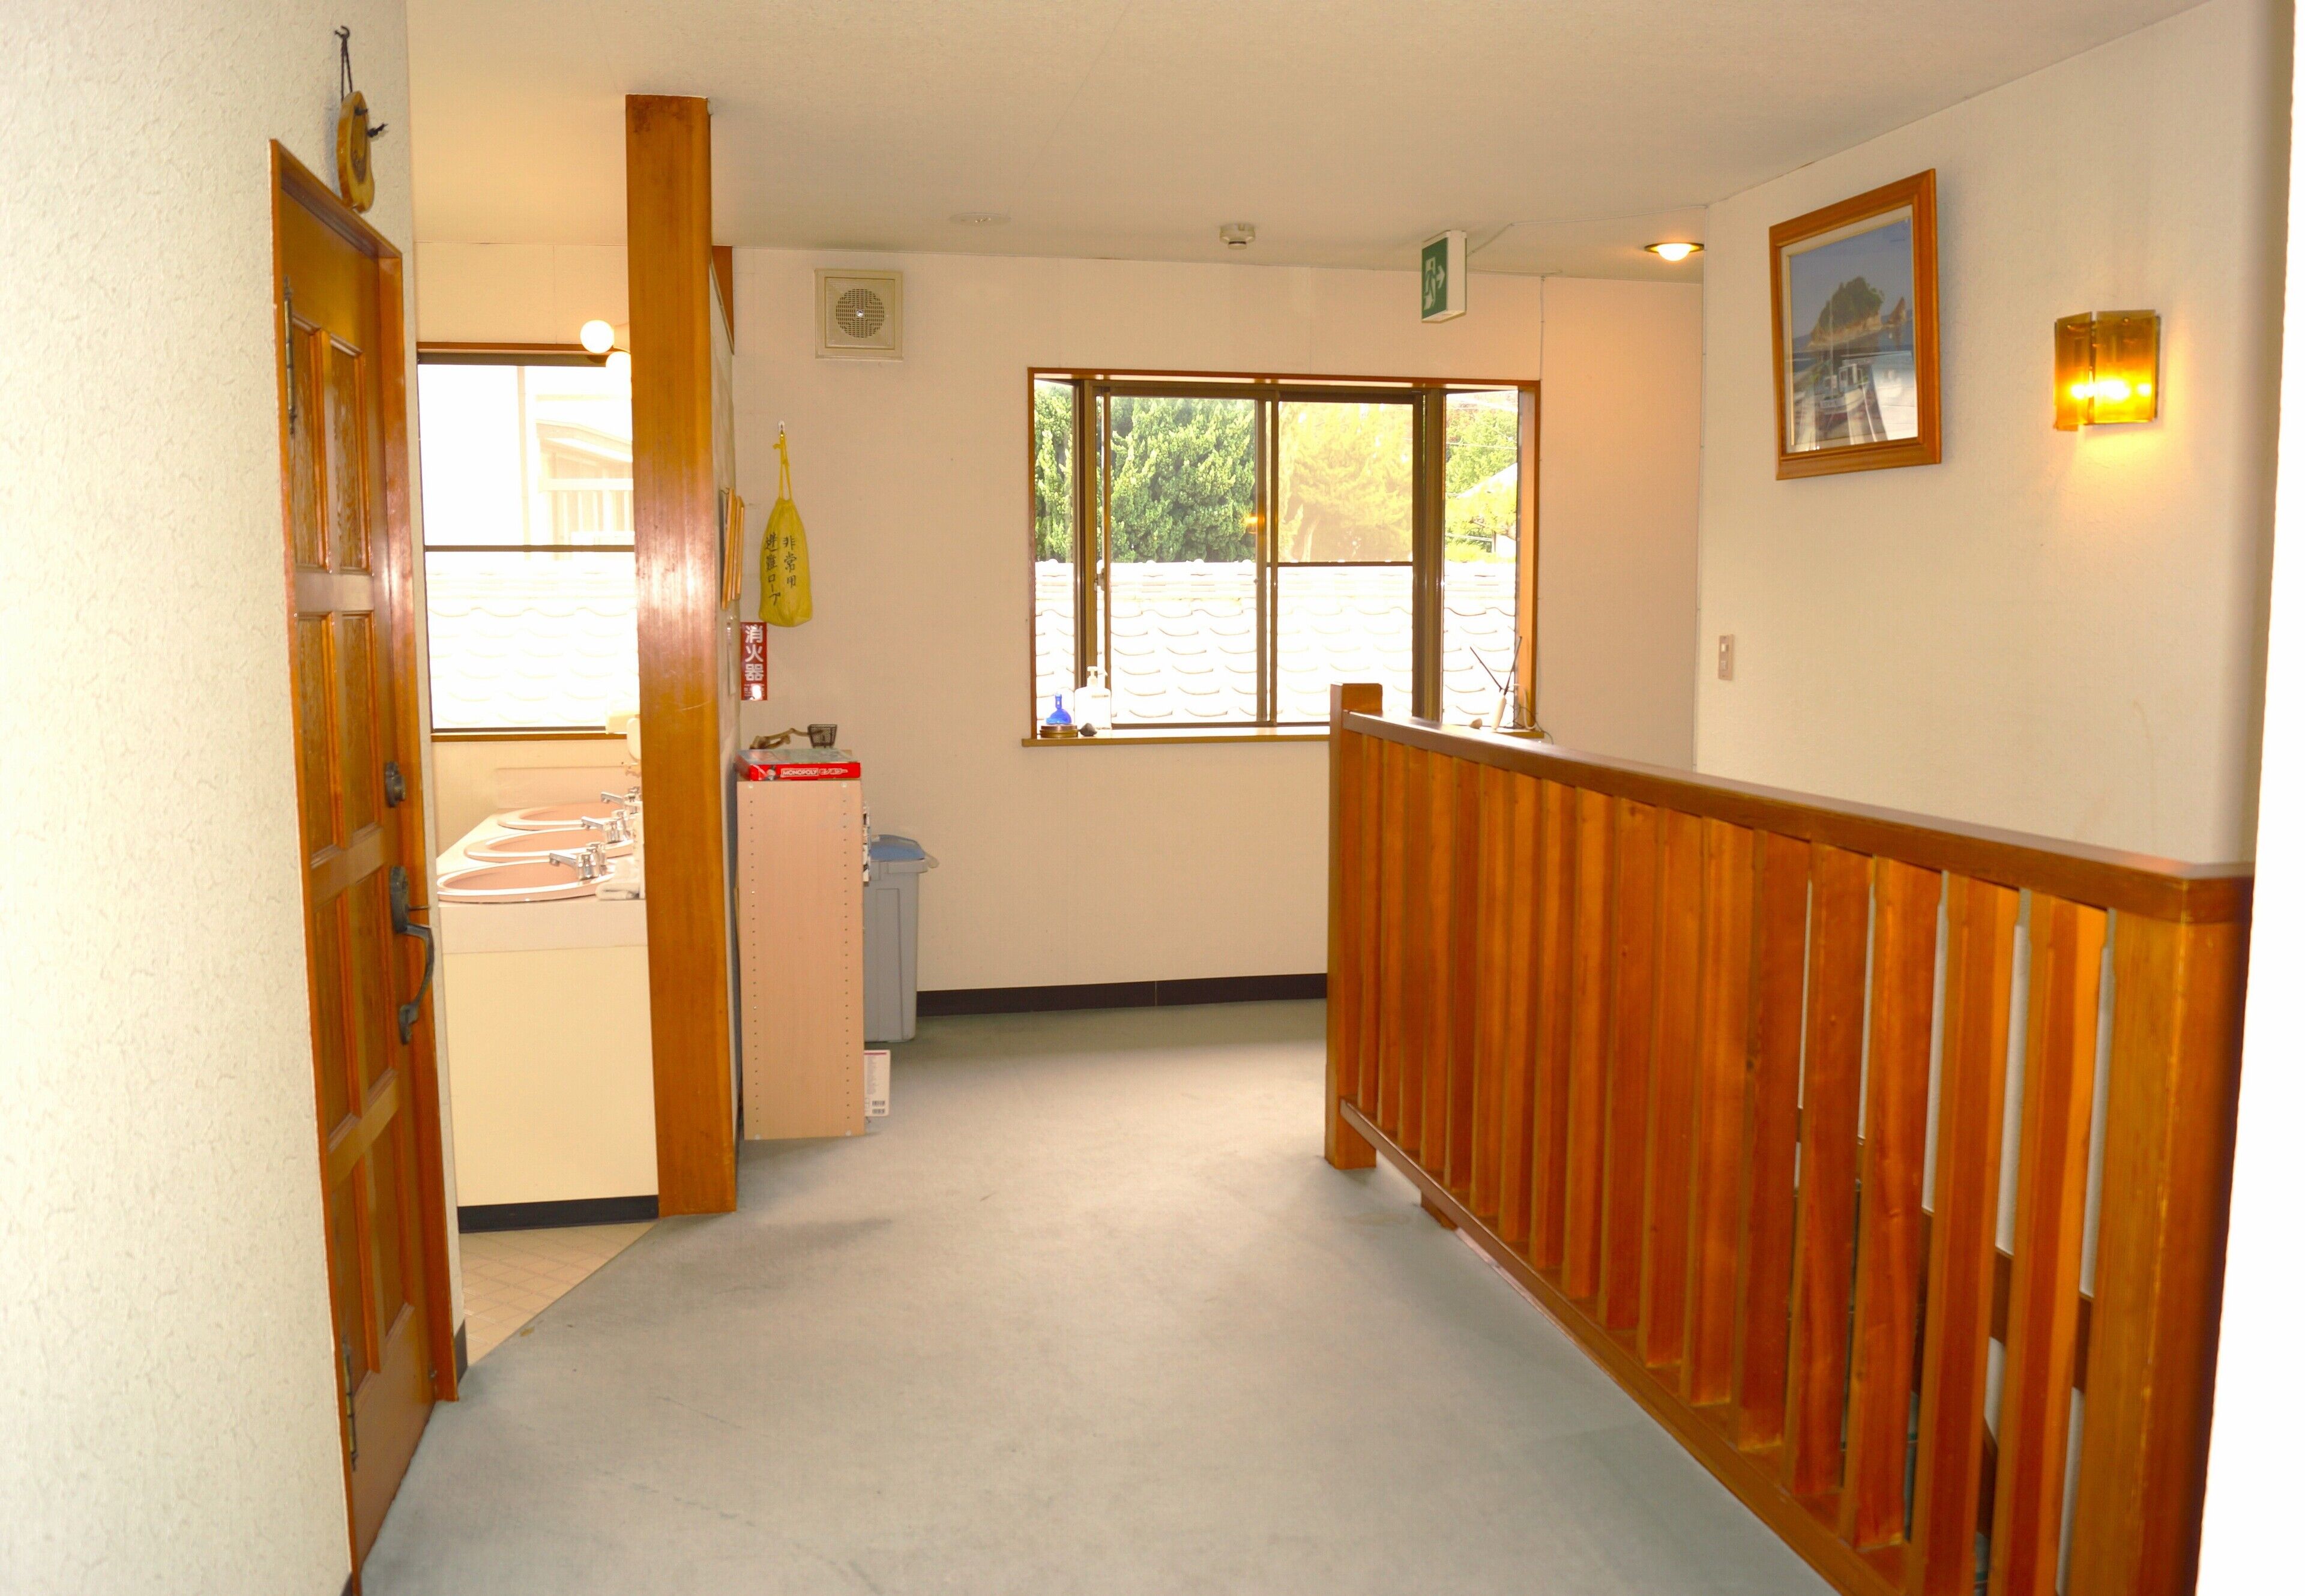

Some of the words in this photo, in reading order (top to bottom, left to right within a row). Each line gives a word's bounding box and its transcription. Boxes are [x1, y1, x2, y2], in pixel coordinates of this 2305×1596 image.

[783, 535, 797, 588] 非常用
[744, 624, 764, 681] 消火器
[782, 768, 818, 777] MONOPOLY
